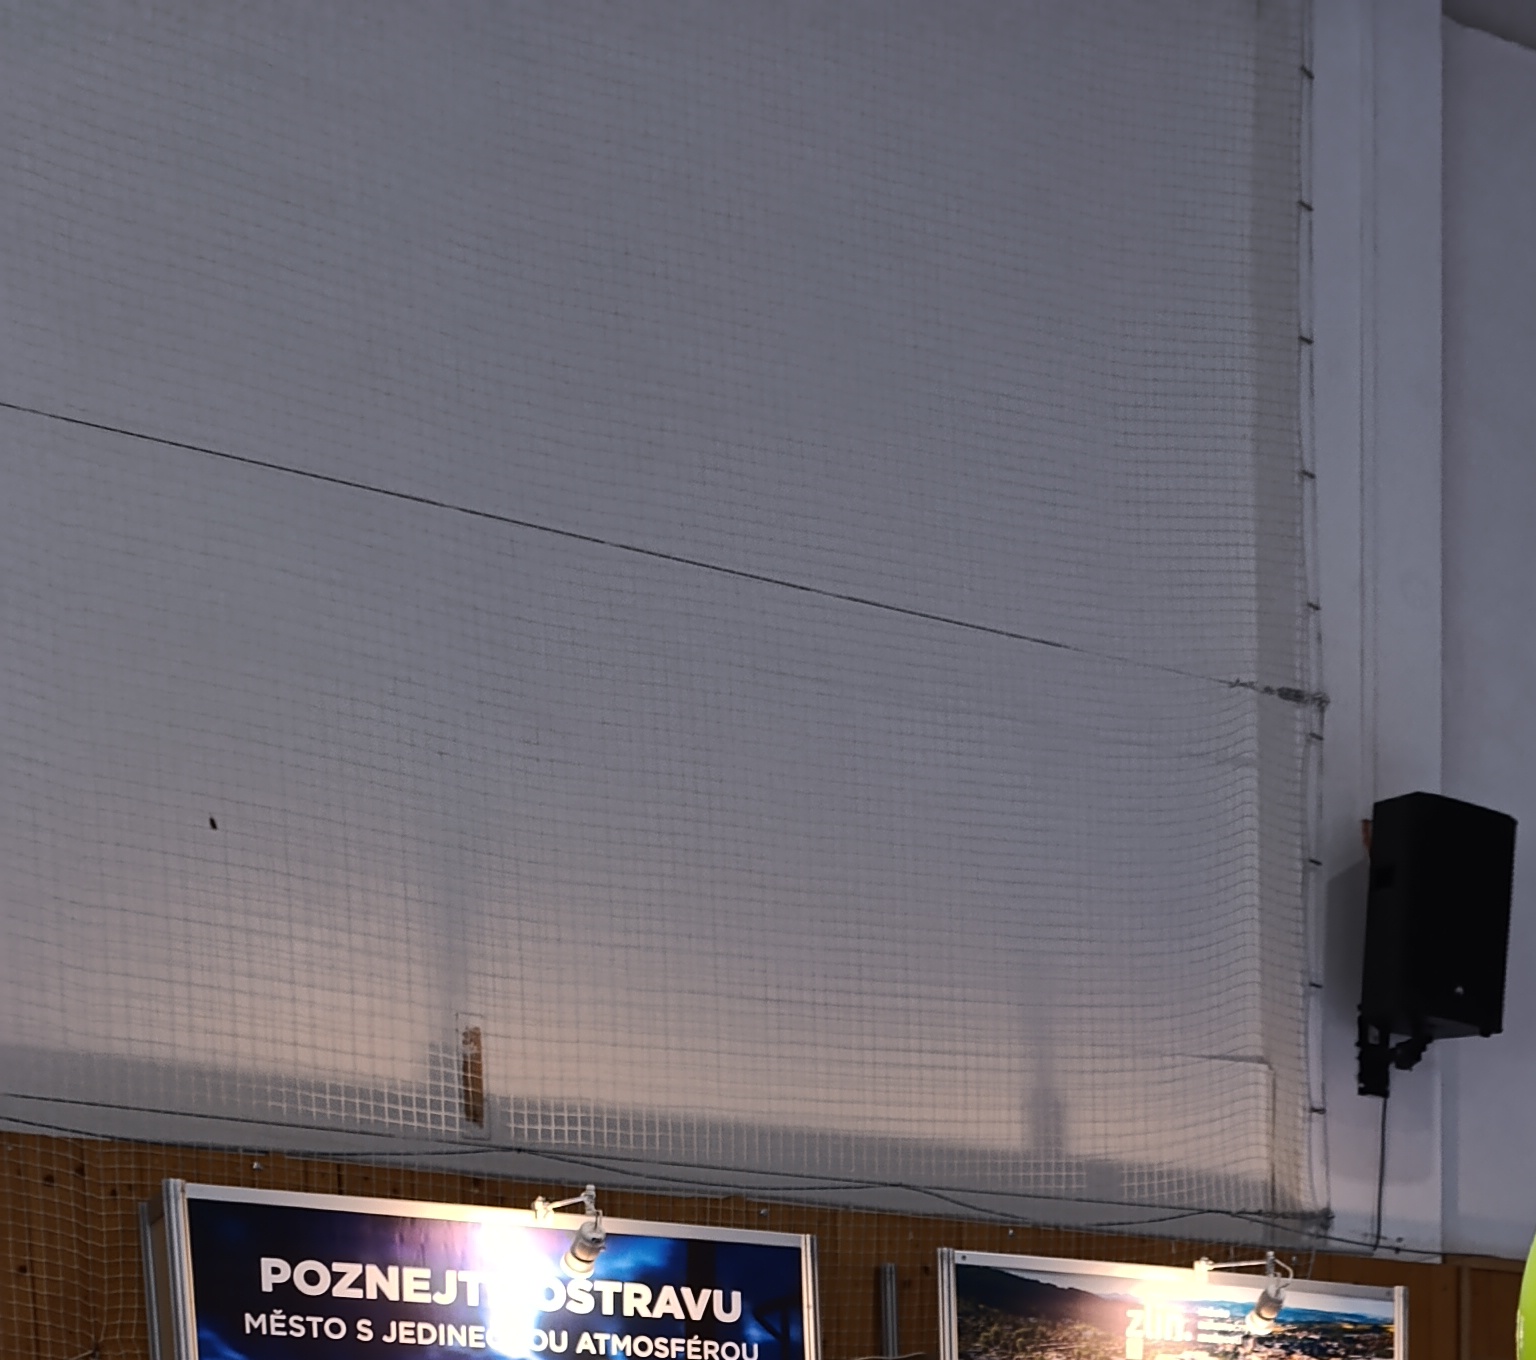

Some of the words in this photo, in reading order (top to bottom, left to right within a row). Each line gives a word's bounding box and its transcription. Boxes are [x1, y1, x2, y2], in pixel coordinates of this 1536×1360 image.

[260, 1256, 485, 1308] POZNEJT
[534, 1276, 743, 1324] OSTRAVU
[243, 1309, 348, 1340] MĚSTO
[355, 1318, 375, 1343] S
[381, 1320, 569, 1355] JEDINEOU
